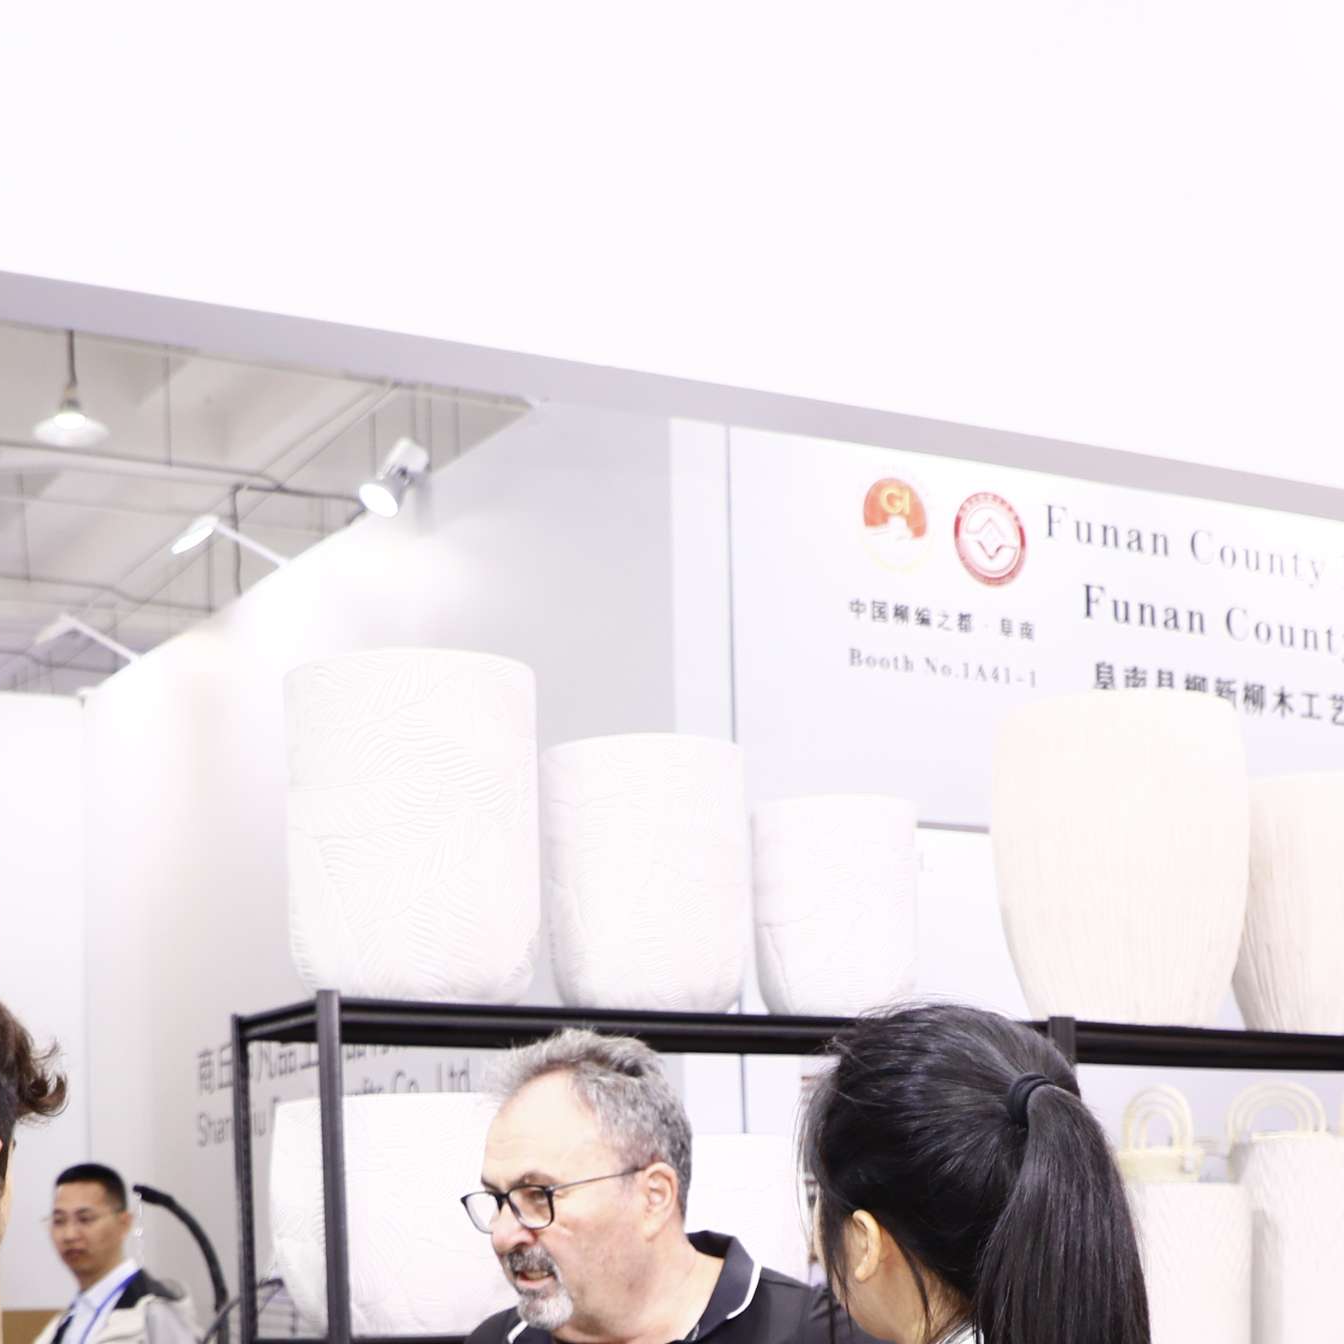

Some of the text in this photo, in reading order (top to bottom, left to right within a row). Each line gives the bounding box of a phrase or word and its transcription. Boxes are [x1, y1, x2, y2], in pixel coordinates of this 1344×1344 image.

[1044, 504, 1170, 557] Funan
[1190, 529, 1323, 588] County
[1081, 583, 1207, 636] Funan
[848, 648, 915, 673] Booth
